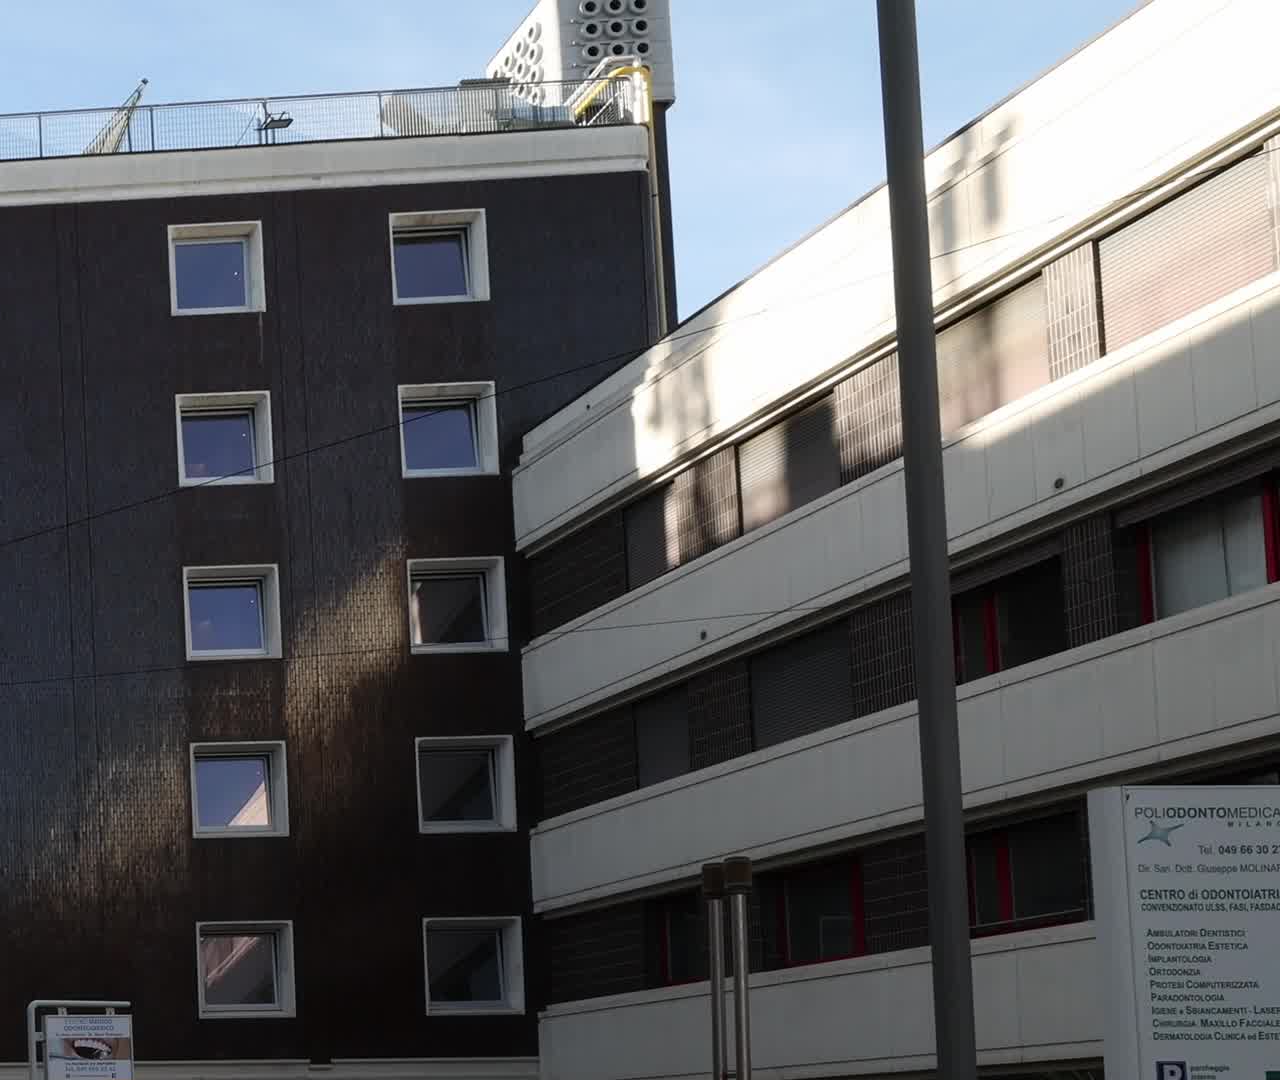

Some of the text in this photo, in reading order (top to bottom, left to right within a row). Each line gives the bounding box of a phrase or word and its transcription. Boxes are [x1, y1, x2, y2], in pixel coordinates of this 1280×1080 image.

[1218, 845, 1237, 855] 049
[1240, 845, 1253, 855] 66
[1255, 845, 1269, 855] 30
[1140, 889, 1185, 900] CENTRO
[1188, 889, 1198, 900] di
[1141, 903, 1203, 912] CONVENZIONATO
